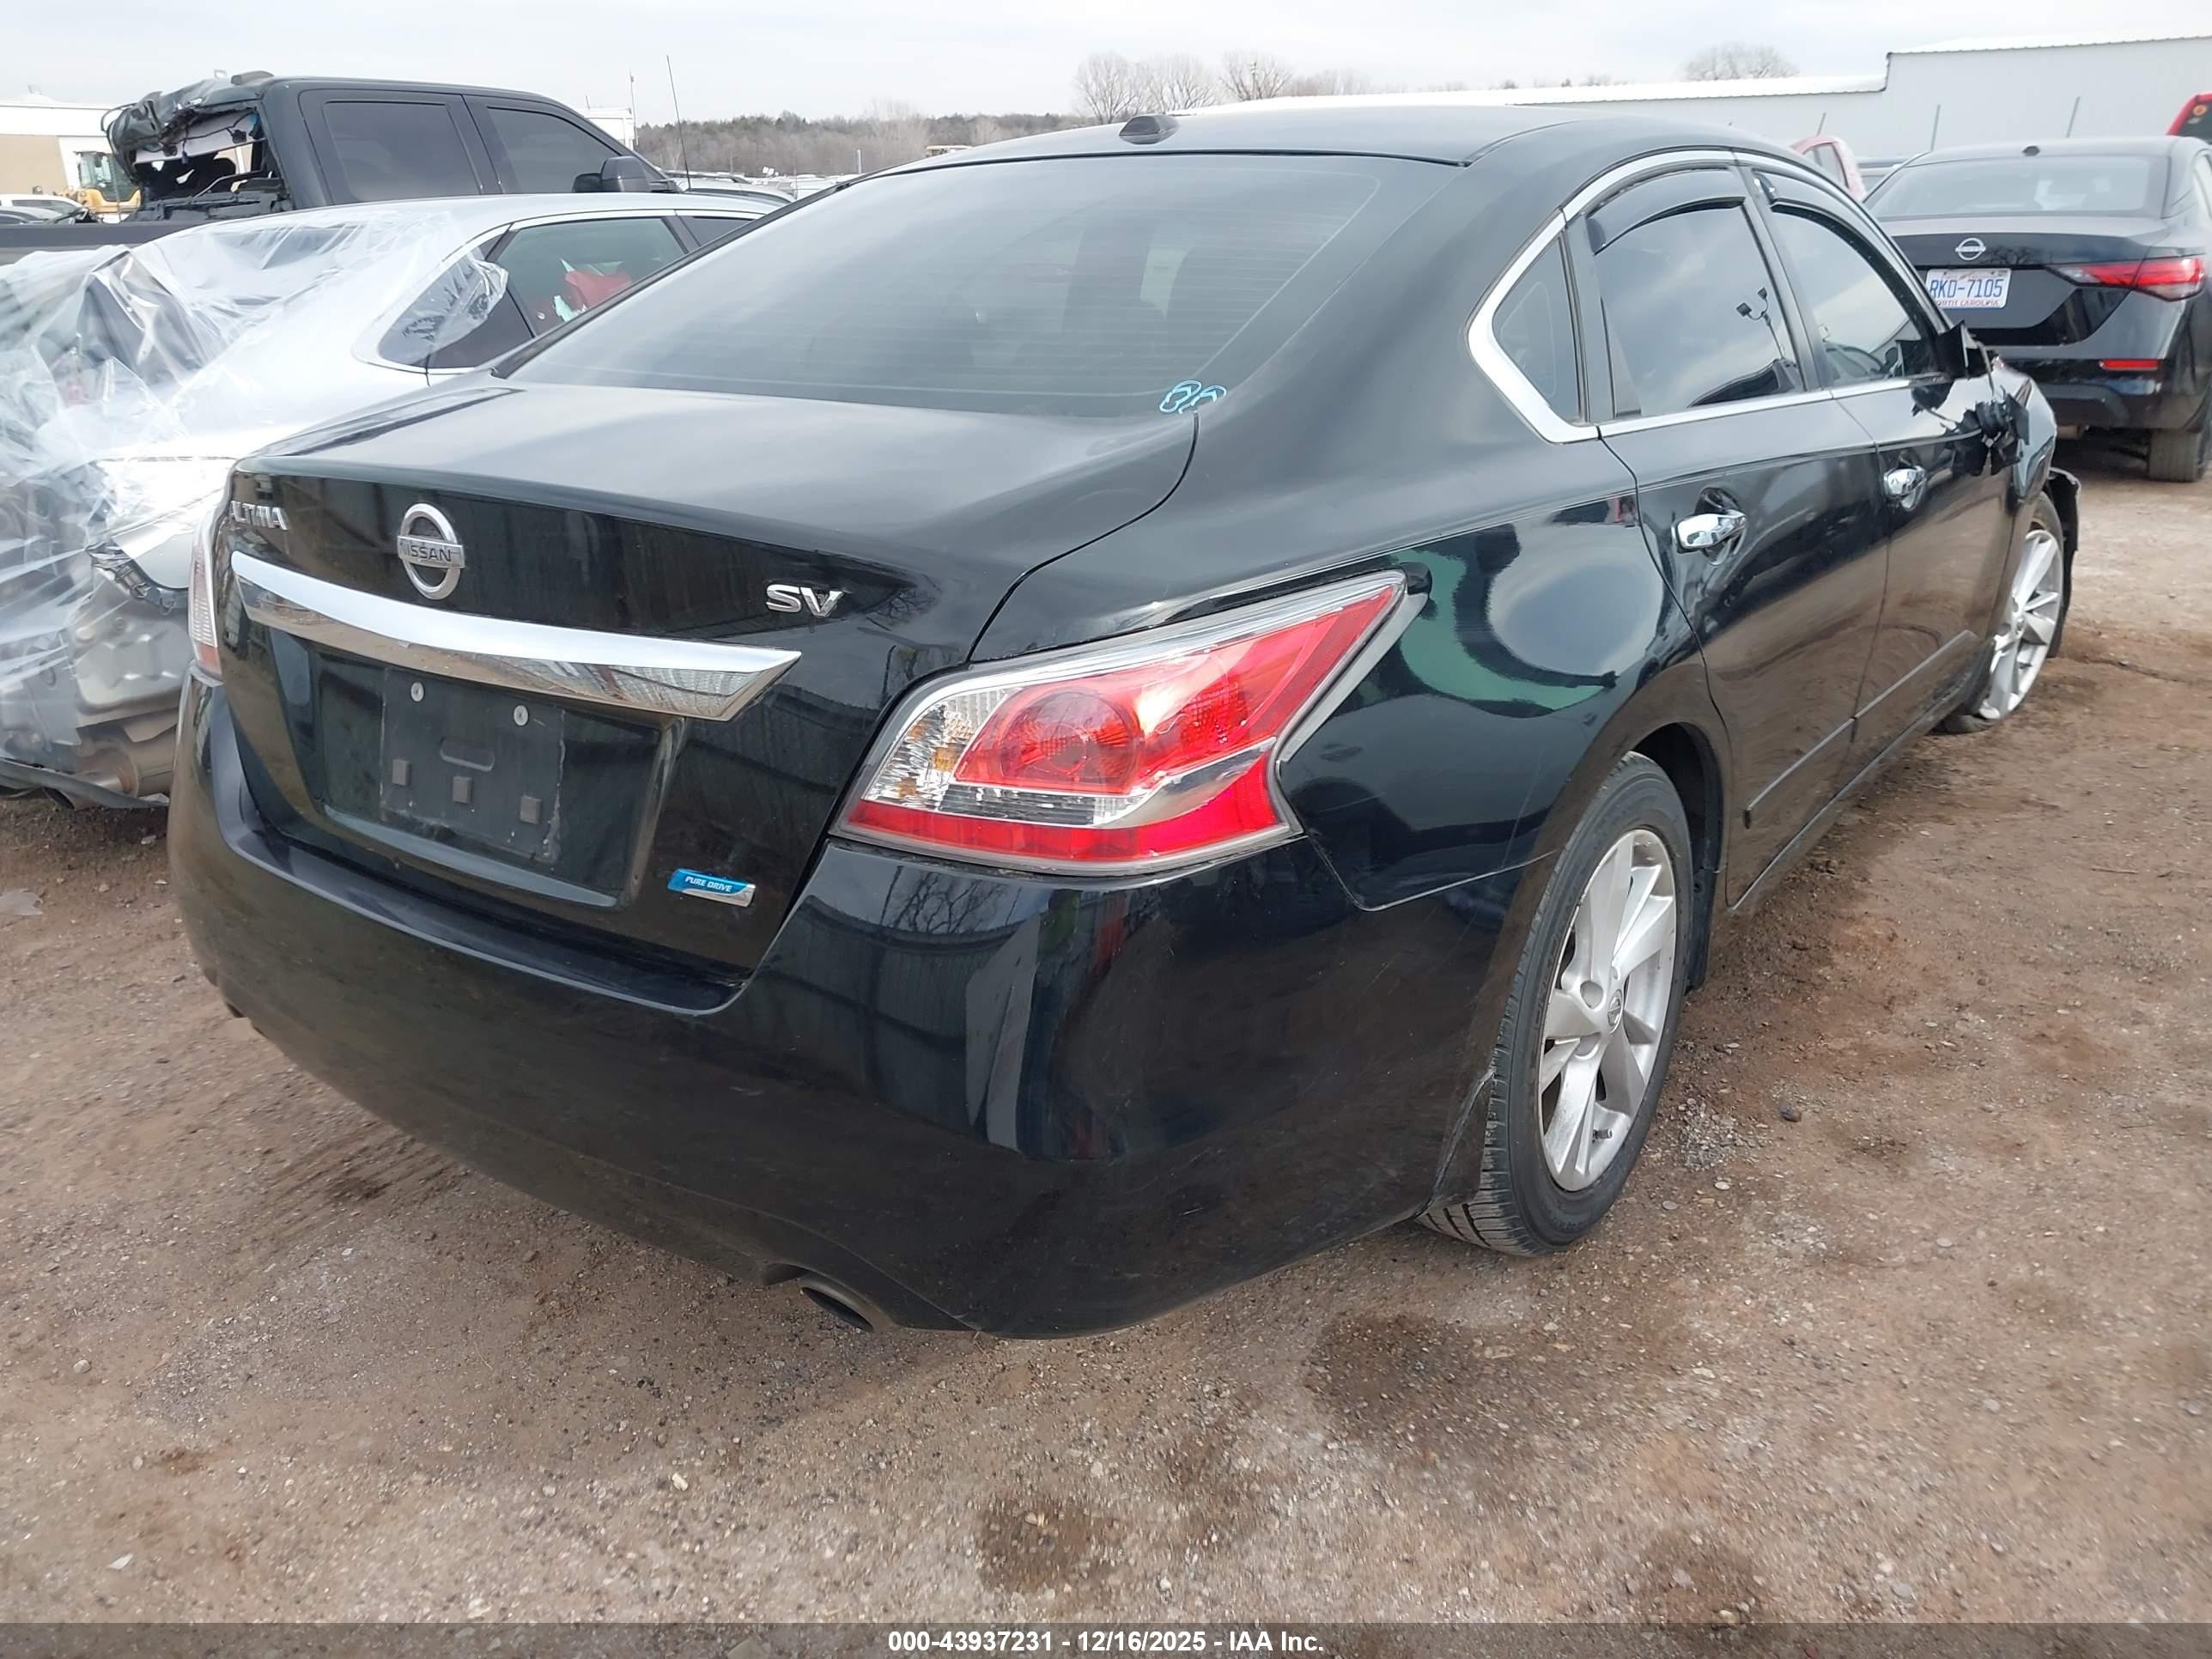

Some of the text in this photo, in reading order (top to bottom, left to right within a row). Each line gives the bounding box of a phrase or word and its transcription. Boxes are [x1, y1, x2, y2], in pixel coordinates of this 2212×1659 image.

[1929, 279, 2004, 298] RKD-7105
[399, 540, 452, 562] NISSAN
[766, 584, 844, 617] SV
[685, 876, 733, 892] PURE DRIVE
